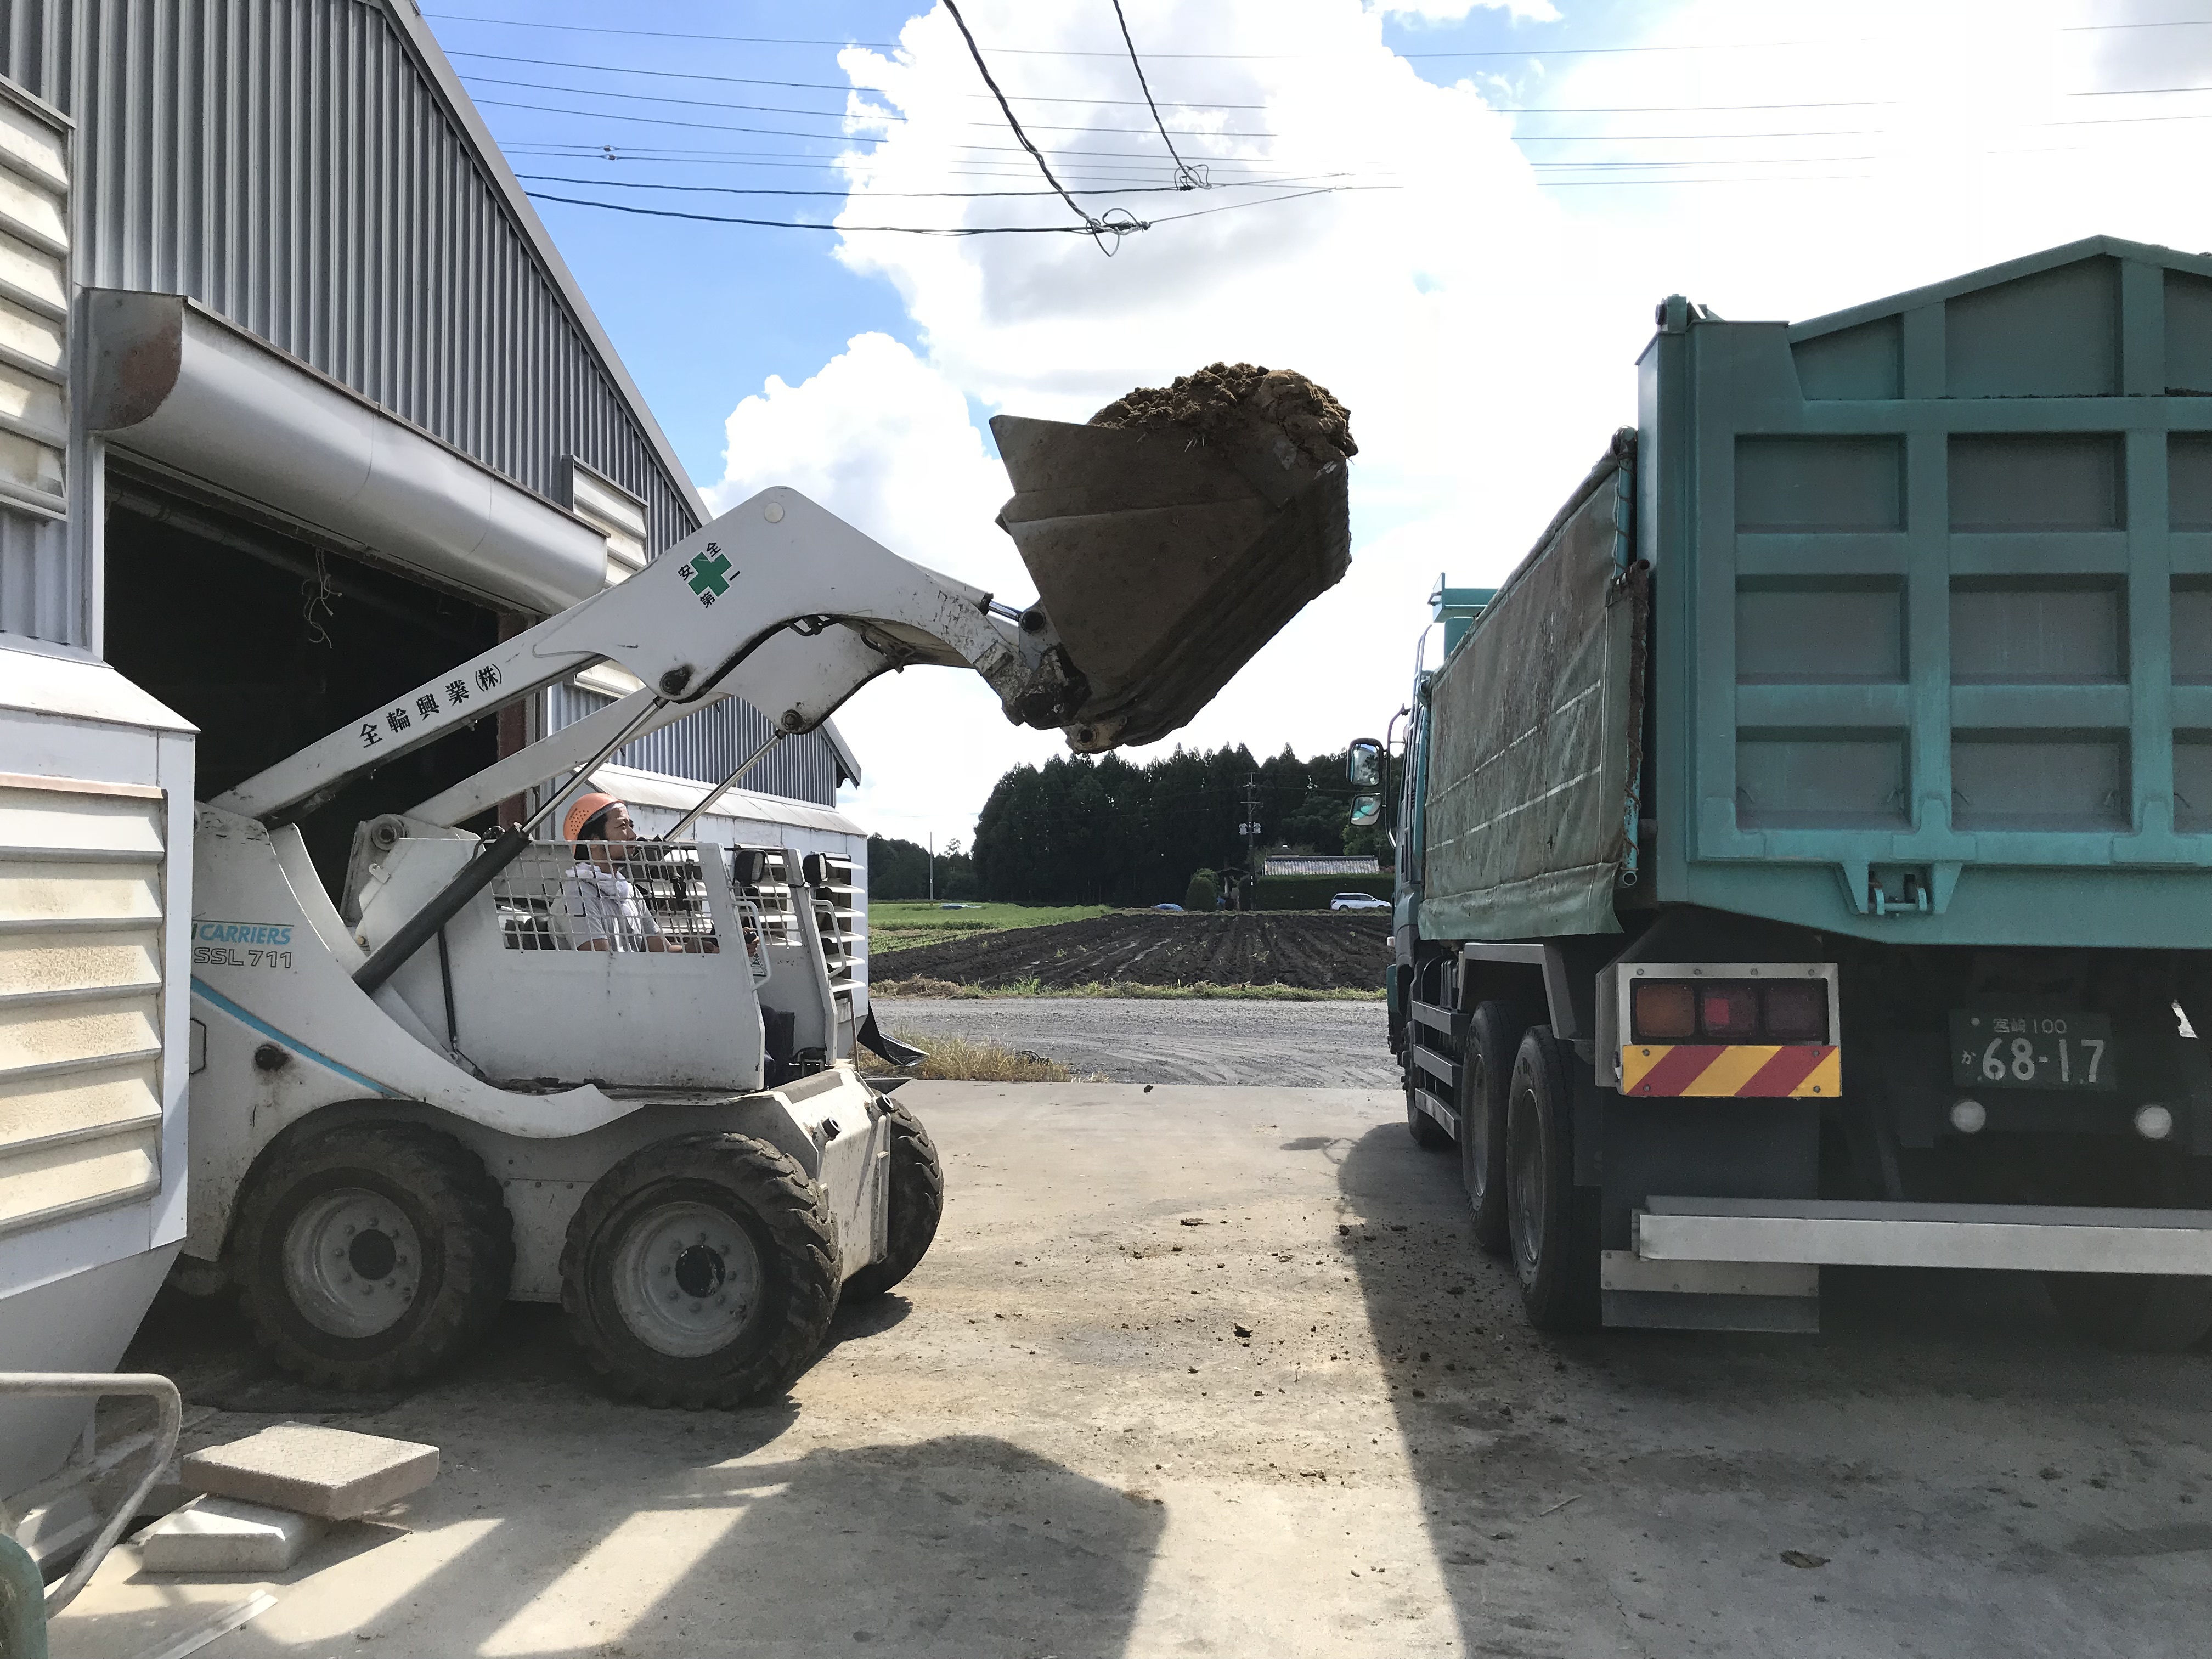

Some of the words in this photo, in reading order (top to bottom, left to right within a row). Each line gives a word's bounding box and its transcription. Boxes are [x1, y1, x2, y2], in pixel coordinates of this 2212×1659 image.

[199, 923, 292, 945] CARRIERS
[2033, 1019, 2067, 1034] 100
[1982, 1037, 2104, 1083] 68-17
